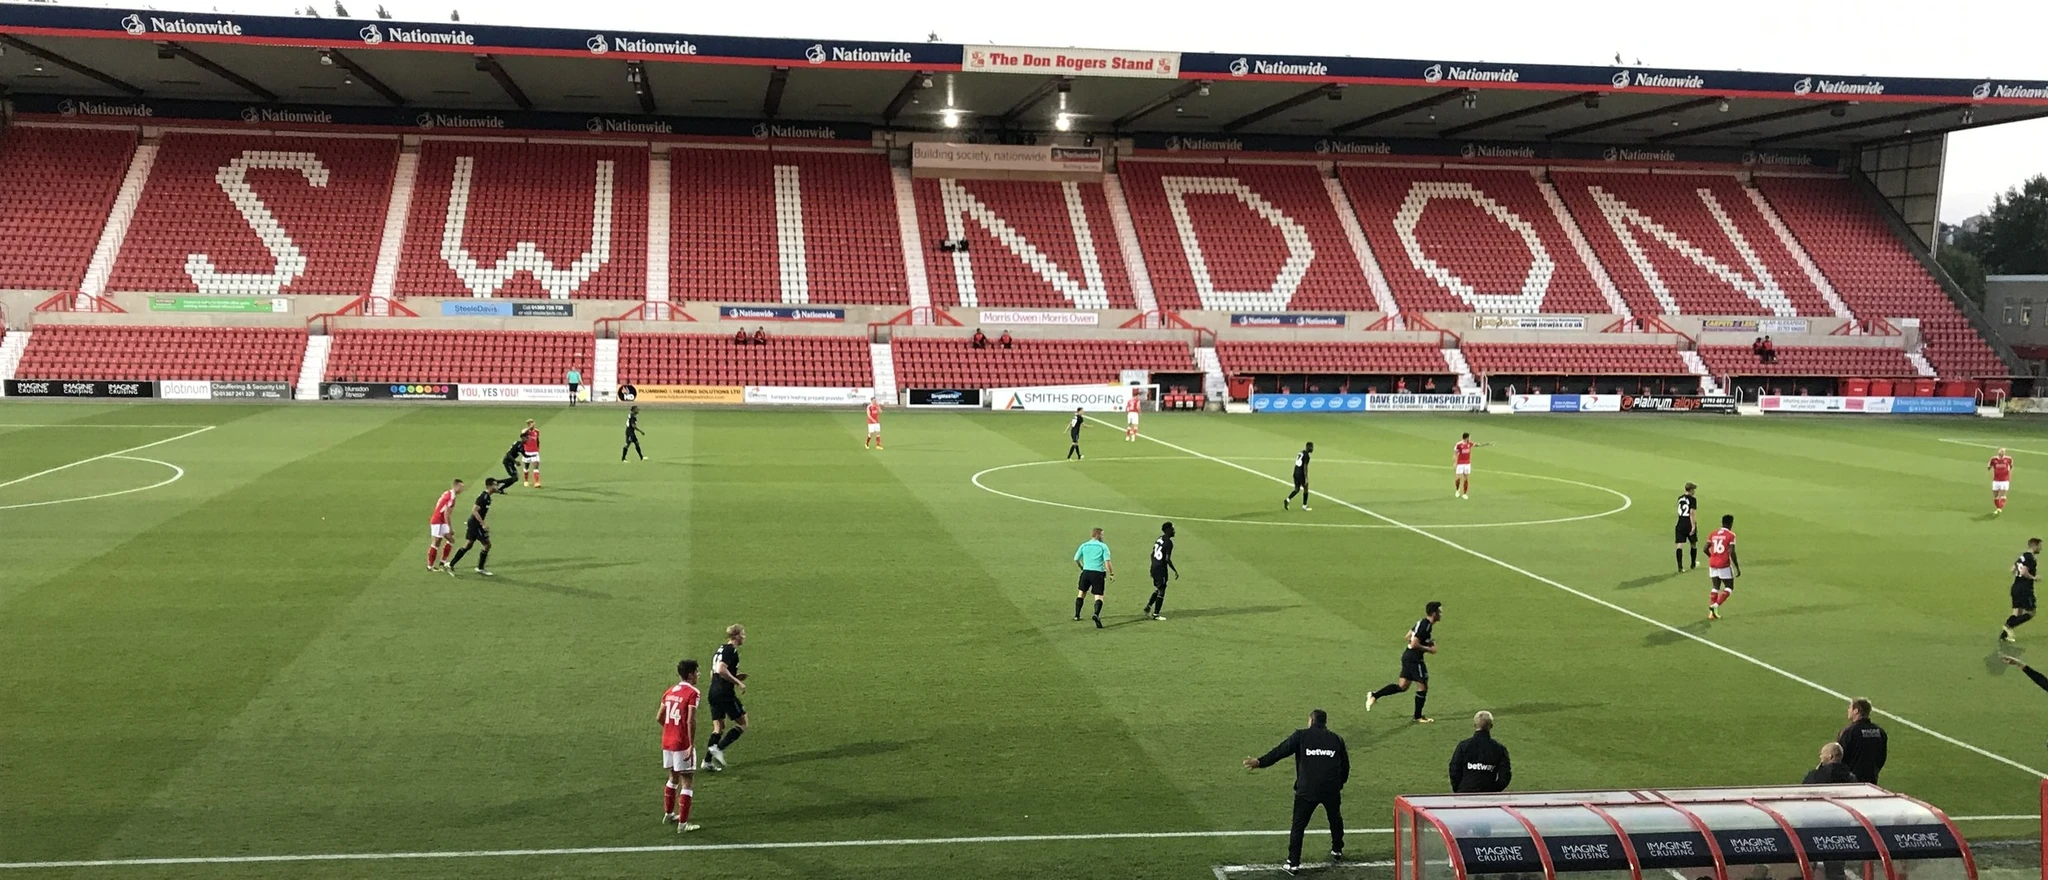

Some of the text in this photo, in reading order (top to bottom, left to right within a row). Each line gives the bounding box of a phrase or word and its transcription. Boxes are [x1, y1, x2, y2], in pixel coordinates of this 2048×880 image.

[151, 17, 242, 36] Nationwide
[388, 27, 474, 46] Nationwide
[615, 37, 697, 56] Nationwide
[832, 46, 911, 63] Nationwide
[990, 52, 1154, 72] The Don Rogers Stand
[1253, 60, 1327, 76] Nationwide
[1447, 66, 1519, 82] Nationwide
[1634, 72, 1704, 89] Nationwide
[1815, 80, 1884, 95] Nationwide
[1993, 84, 2048, 98] Nationwi
[79, 100, 153, 118] Nationwide
[262, 109, 332, 124] Nationwide
[435, 114, 504, 129] Nationwide
[605, 119, 673, 134] Nationwide
[771, 124, 836, 139] Nationwide
[1182, 138, 1242, 151] Nationwide
[1331, 141, 1391, 155] Nationwide
[914, 148, 1046, 162] Building society, nationwide
[1476, 145, 1535, 159] Nationwide
[1619, 148, 1676, 162] Nationwide
[1758, 152, 1812, 166] Nationwide
[454, 304, 498, 312] SteeleDavis
[740, 310, 774, 318] Nationwide
[801, 310, 836, 318] Nationwide
[984, 312, 1037, 322] Morris Owen
[1042, 313, 1094, 322] Morris Owen
[164, 383, 208, 396] platinum
[461, 388, 481, 398] YOU,
[482, 388, 498, 397] YES
[500, 388, 518, 397] YOU!
[1024, 392, 1124, 404] SMITHS ROOFING
[1370, 396, 1481, 404] DAVE COBB TRANSPORT LTD
[1674, 396, 1700, 410] alloys
[1712, 540, 1725, 553] 16
[665, 701, 681, 726] 14
[1306, 748, 1335, 758] betway
[1467, 762, 1496, 772] betway
[1730, 837, 1775, 848] IMAGINE
[1812, 835, 1857, 845] IMAGINE
[1894, 832, 1939, 843] IMAGINE
[1898, 840, 1942, 848] CRUISING
[1474, 846, 1522, 856] IMAGINE
[1561, 844, 1608, 854] IMAGINE
[1646, 841, 1692, 851] IMAGINE
[1650, 848, 1695, 857] CRUISING
[1734, 844, 1778, 853] CRUISING
[1816, 842, 1860, 850] CRUISING
[1477, 853, 1523, 862] CRUISING
[1564, 851, 1610, 860] CRUISING
